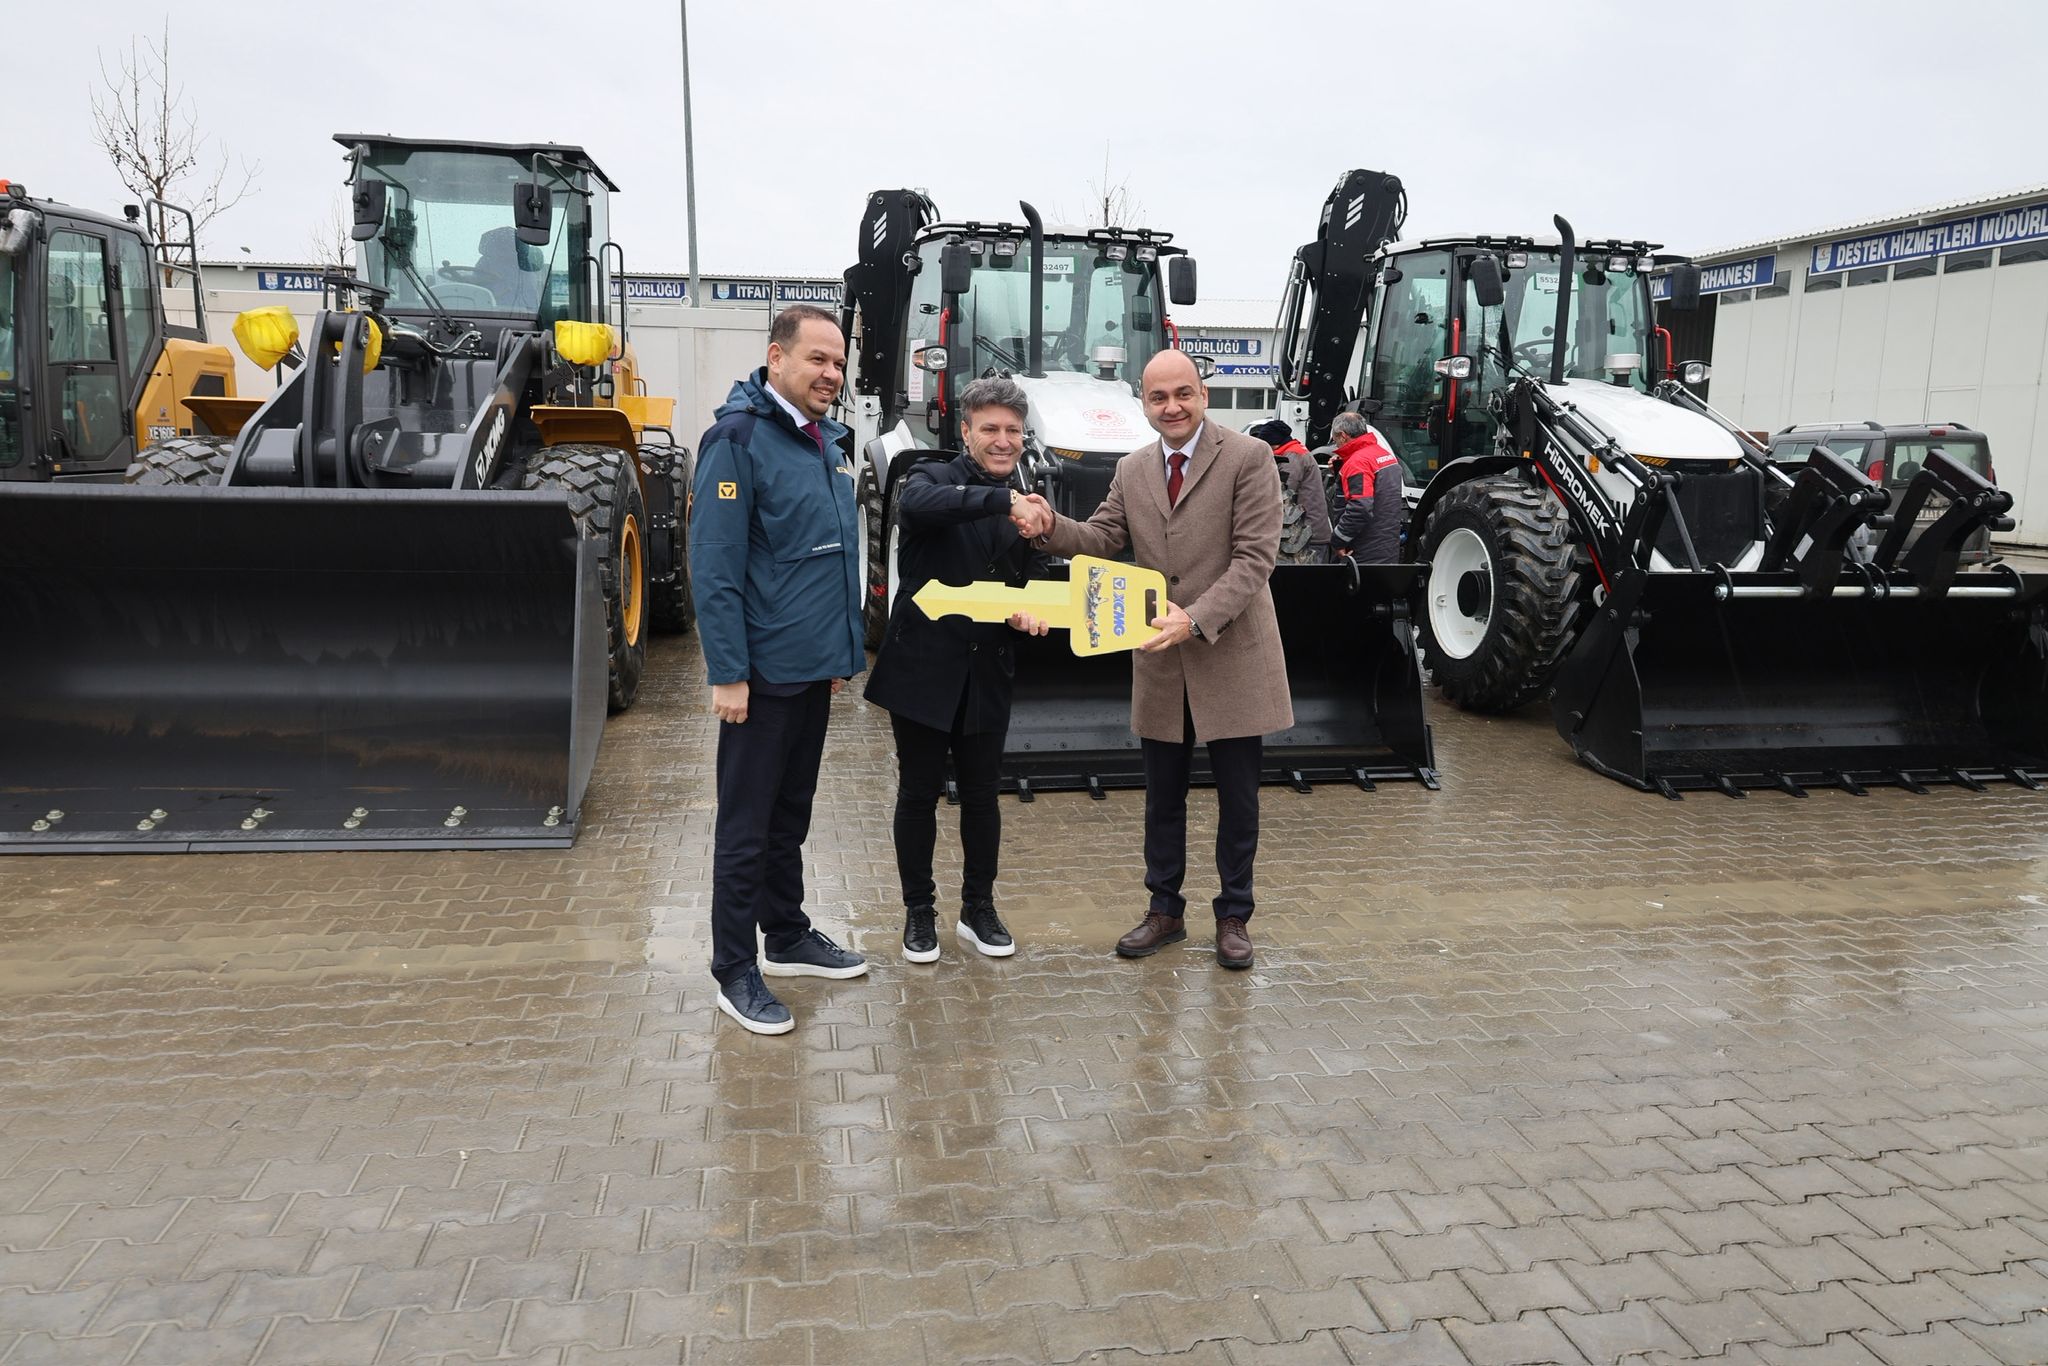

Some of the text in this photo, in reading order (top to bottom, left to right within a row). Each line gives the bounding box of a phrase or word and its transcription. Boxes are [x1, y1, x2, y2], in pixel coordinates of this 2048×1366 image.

[1026, 242, 1088, 250] APHA
[1836, 236, 1889, 267] DESTEK
[1890, 217, 1978, 258] HİZMETLERİ
[1043, 263, 1069, 271] 32497
[1650, 260, 1758, 296] TİK RHANESİ
[611, 281, 680, 297] MDÜRLÜĞÜ
[1113, 591, 1126, 637] XCMG
